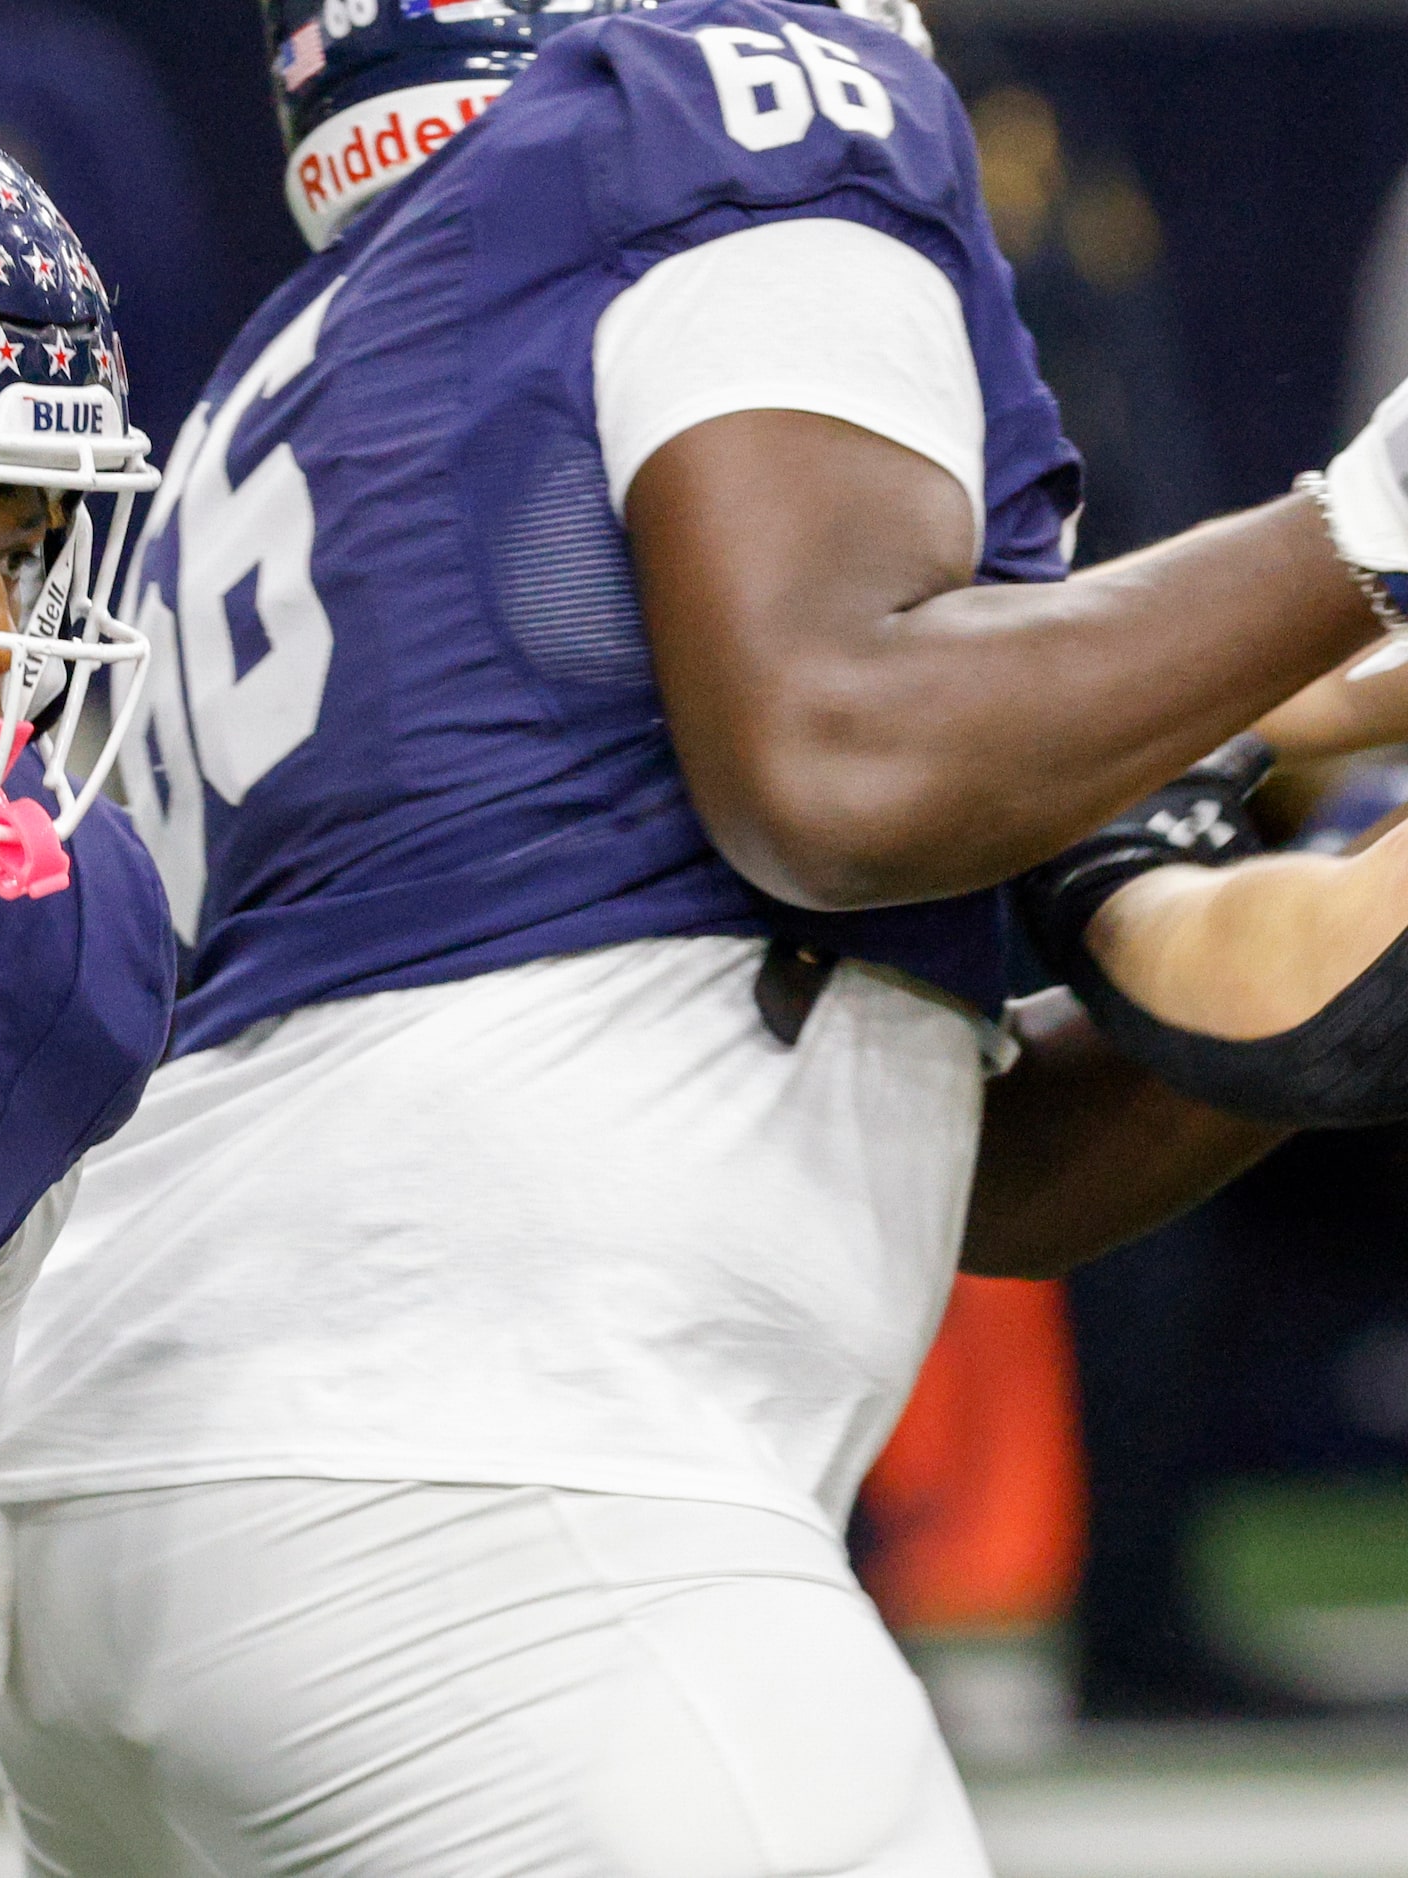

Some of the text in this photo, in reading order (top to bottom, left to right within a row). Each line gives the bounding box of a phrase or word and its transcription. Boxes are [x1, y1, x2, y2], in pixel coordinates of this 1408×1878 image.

[694, 22, 895, 152] 66
[298, 95, 498, 213] Ridde
[32, 401, 104, 434] BLUE
